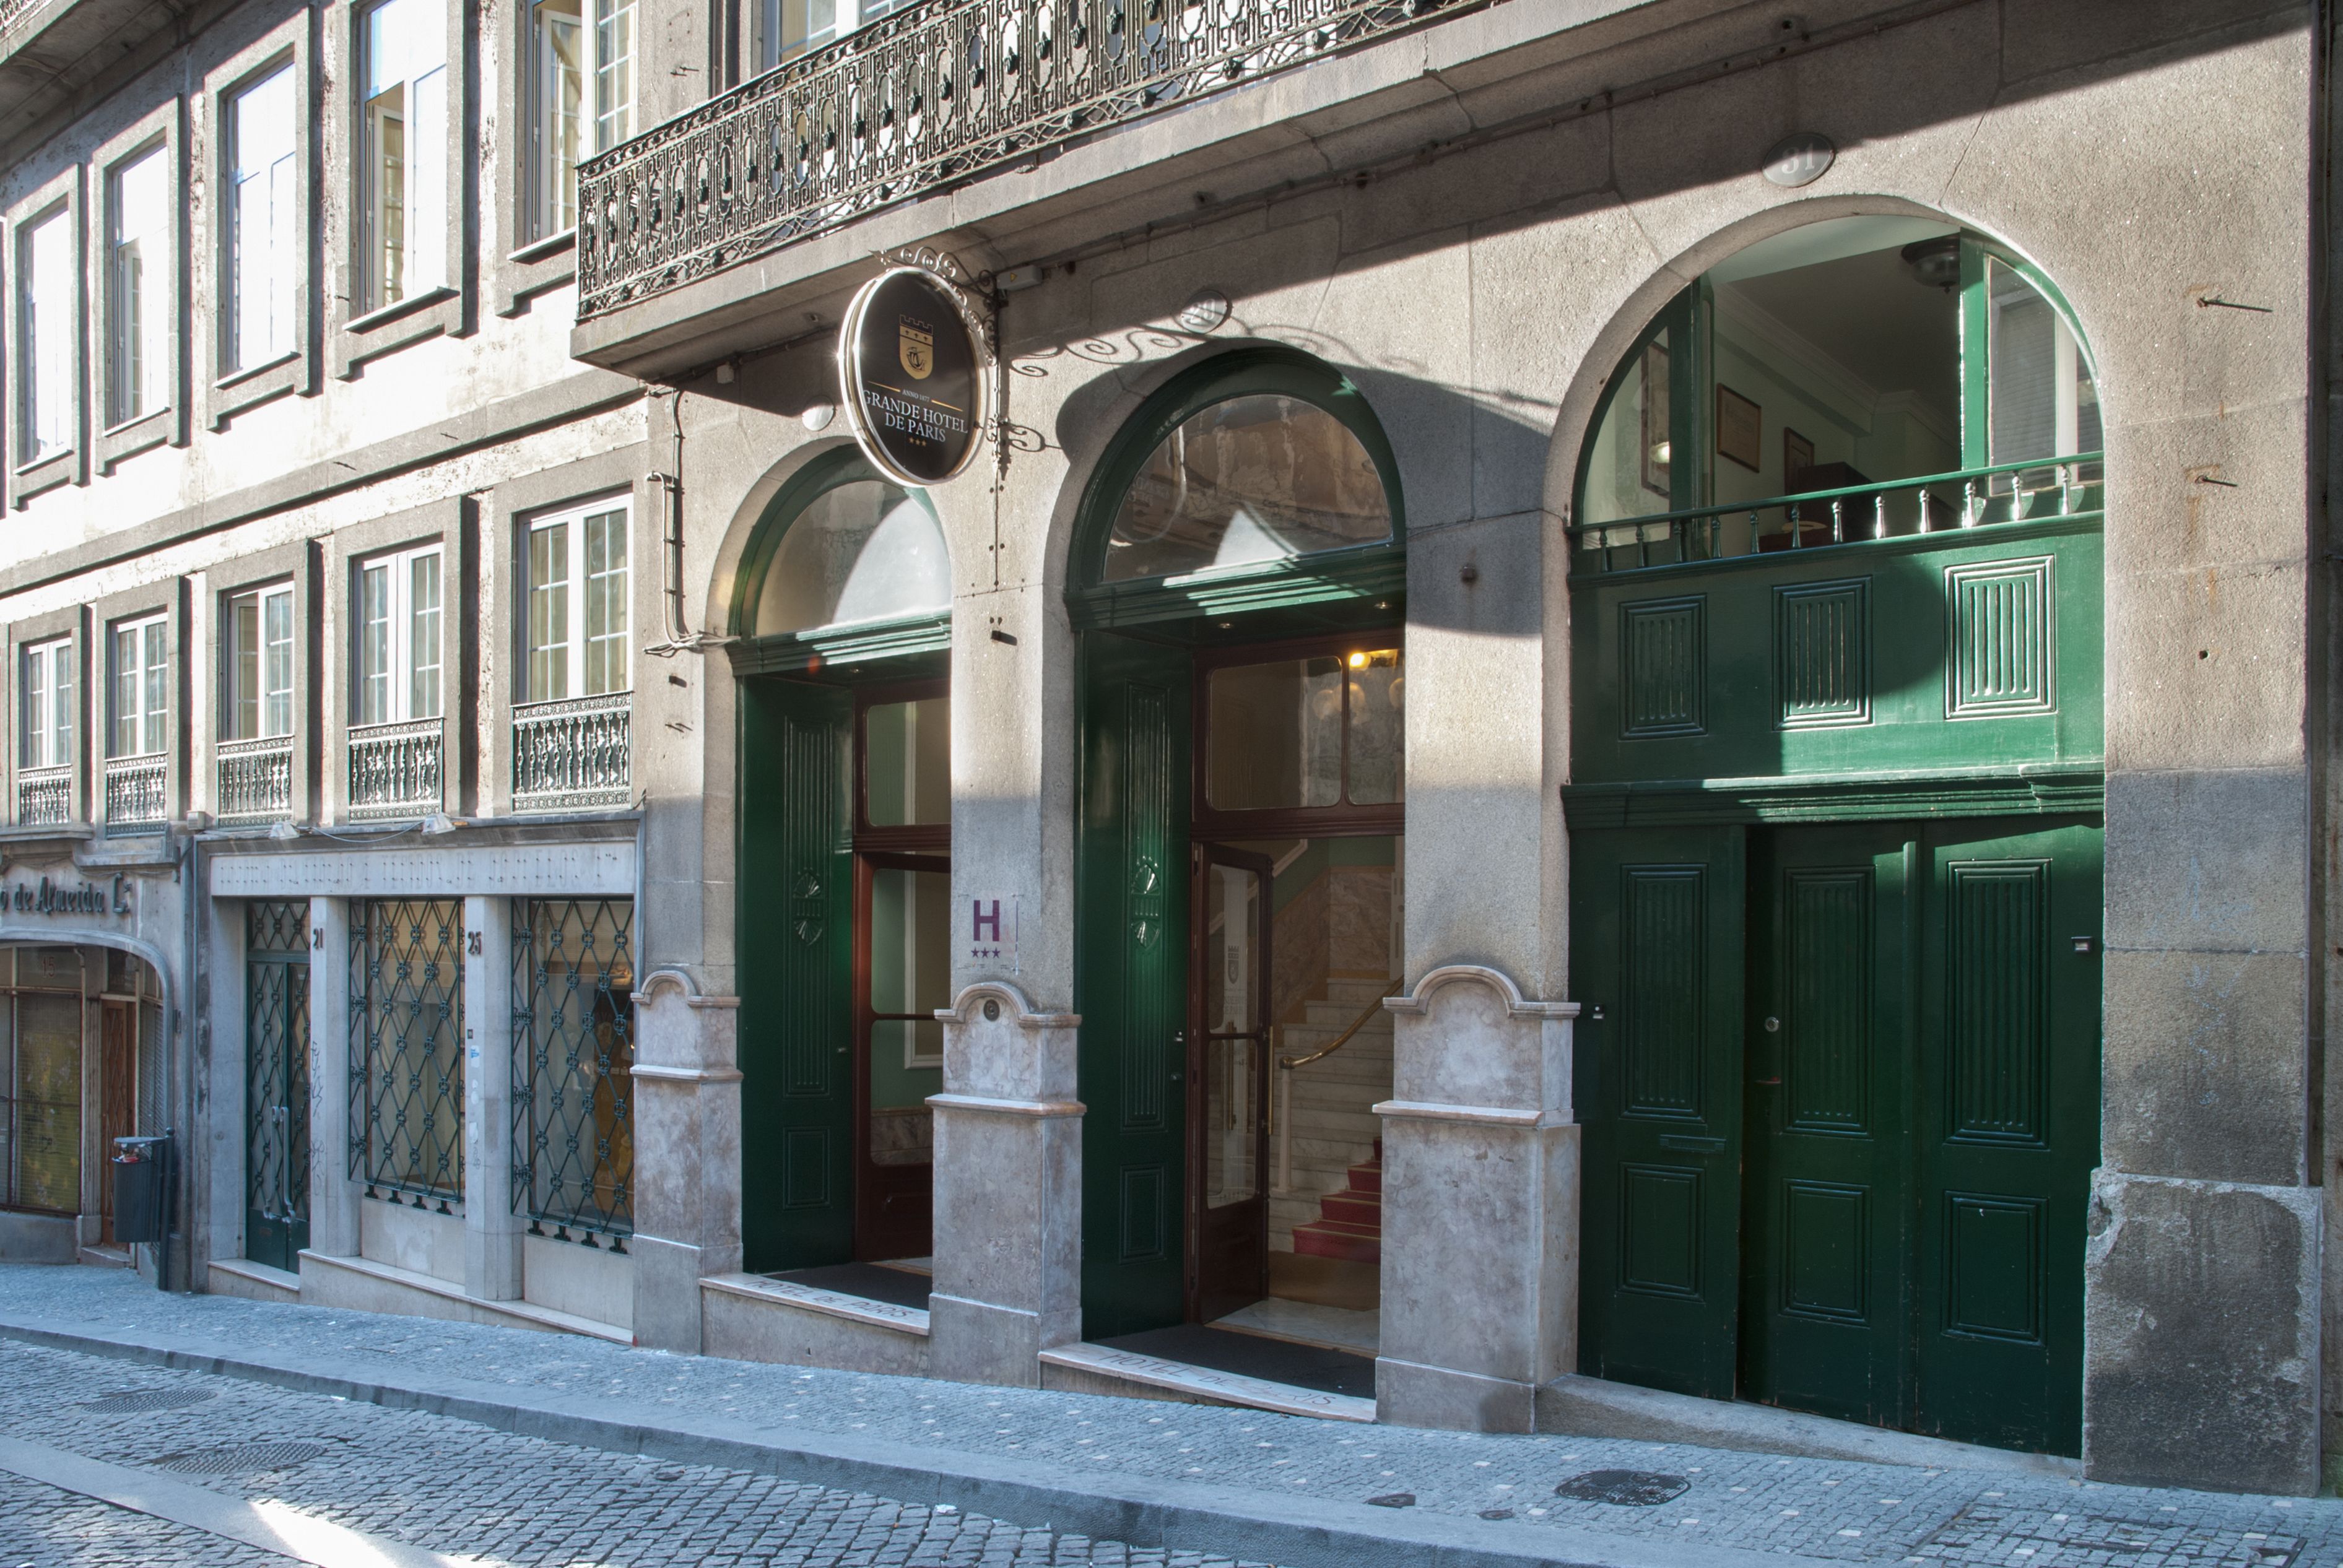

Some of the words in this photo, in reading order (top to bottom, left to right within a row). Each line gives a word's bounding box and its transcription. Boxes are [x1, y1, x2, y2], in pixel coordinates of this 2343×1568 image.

[1781, 142, 1815, 174] 31
[902, 389, 919, 399] ANNO
[863, 390, 920, 420] GRANDE
[923, 408, 968, 434] HOTEL
[885, 412, 905, 430] DE
[908, 419, 945, 441] PARIS
[14, 883, 33, 911] de
[35, 877, 105, 915] Almeida
[973, 900, 1000, 942] H
[313, 928, 324, 950] 21
[468, 931, 482, 956] 25
[42, 956, 55, 977] 15
[744, 1280, 814, 1297] HOTEL
[843, 1301, 913, 1318] PARIS
[1099, 1354, 1189, 1377] HOTEL
[1198, 1375, 1233, 1386] DE
